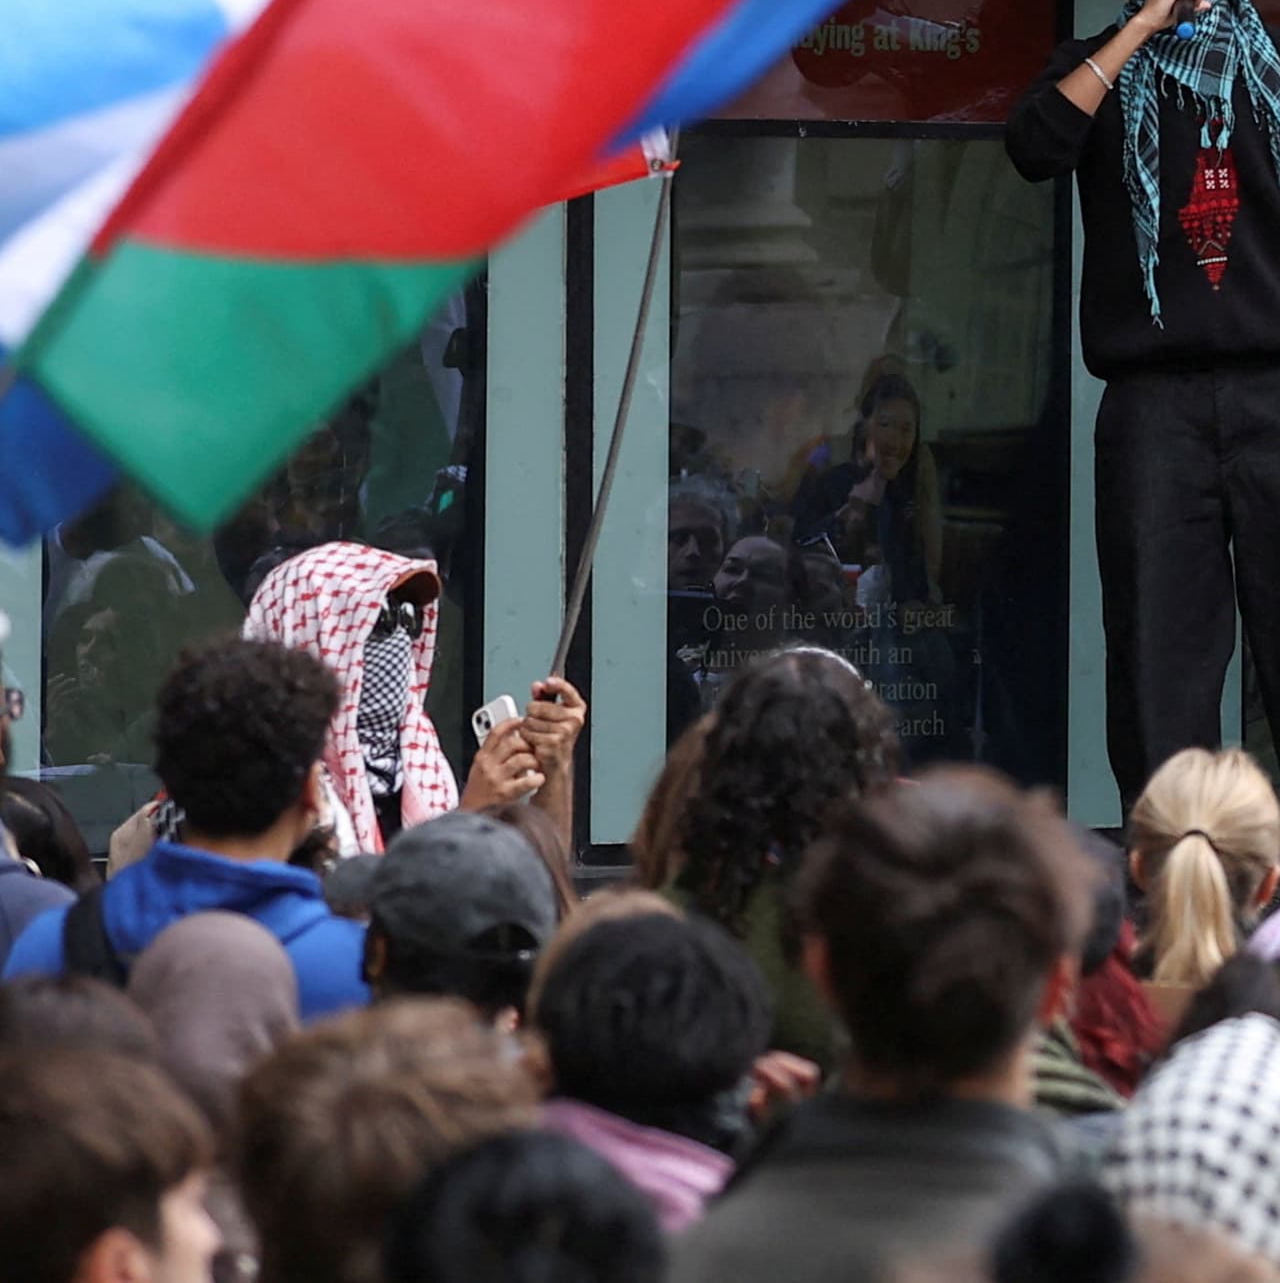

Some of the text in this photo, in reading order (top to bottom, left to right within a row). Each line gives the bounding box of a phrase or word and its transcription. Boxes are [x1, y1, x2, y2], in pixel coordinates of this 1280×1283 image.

[874, 20, 901, 51] at
[702, 605, 748, 631] One
[754, 604, 778, 630] of
[783, 606, 816, 629] the
[903, 604, 956, 635] great
[887, 645, 913, 665] an
